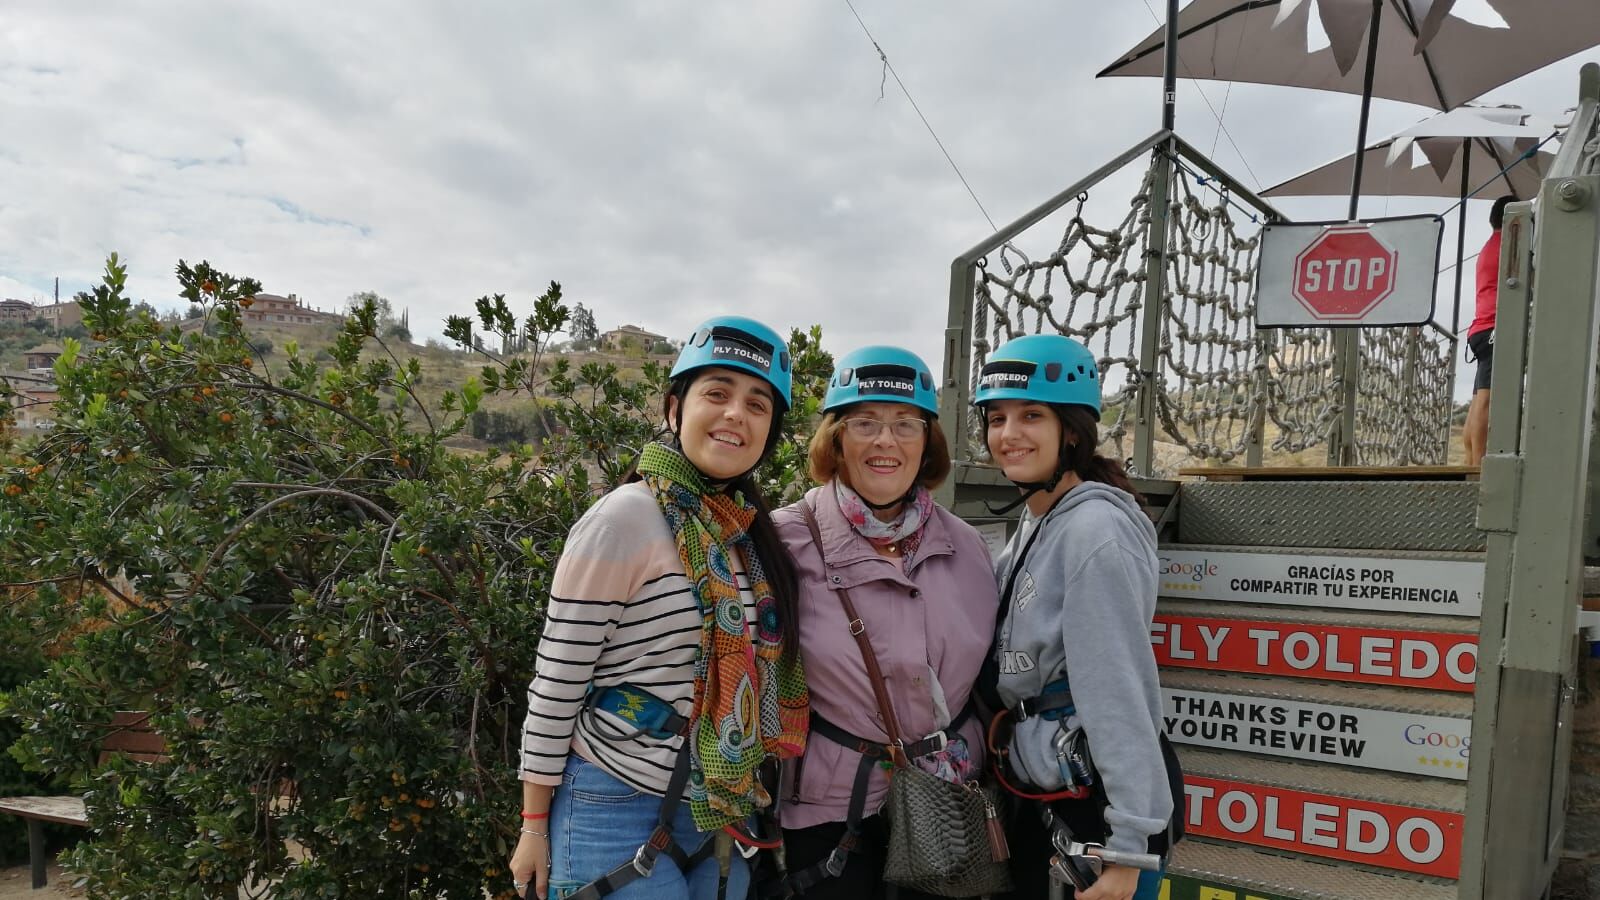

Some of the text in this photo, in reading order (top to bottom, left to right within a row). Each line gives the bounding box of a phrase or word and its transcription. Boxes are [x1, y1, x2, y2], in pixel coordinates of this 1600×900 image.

[1304, 257, 1386, 292] STOP
[713, 346, 770, 367] FLY TOLEDO
[859, 380, 914, 391] FLY TOLEDO
[994, 373, 1028, 382] TOLEDO
[1158, 557, 1218, 582] Google
[1287, 564, 1394, 583] GRACÍAS POR
[1230, 578, 1318, 597] COMPARTIR
[1323, 584, 1343, 597] TU
[1349, 584, 1459, 604] EXPERIENCIA
[1248, 628, 1478, 684] TOLEDO
[1172, 695, 1358, 734] THANKS FOR
[1163, 717, 1366, 758] YOUR REVIEW
[1184, 783, 1444, 864] TOLEDO
